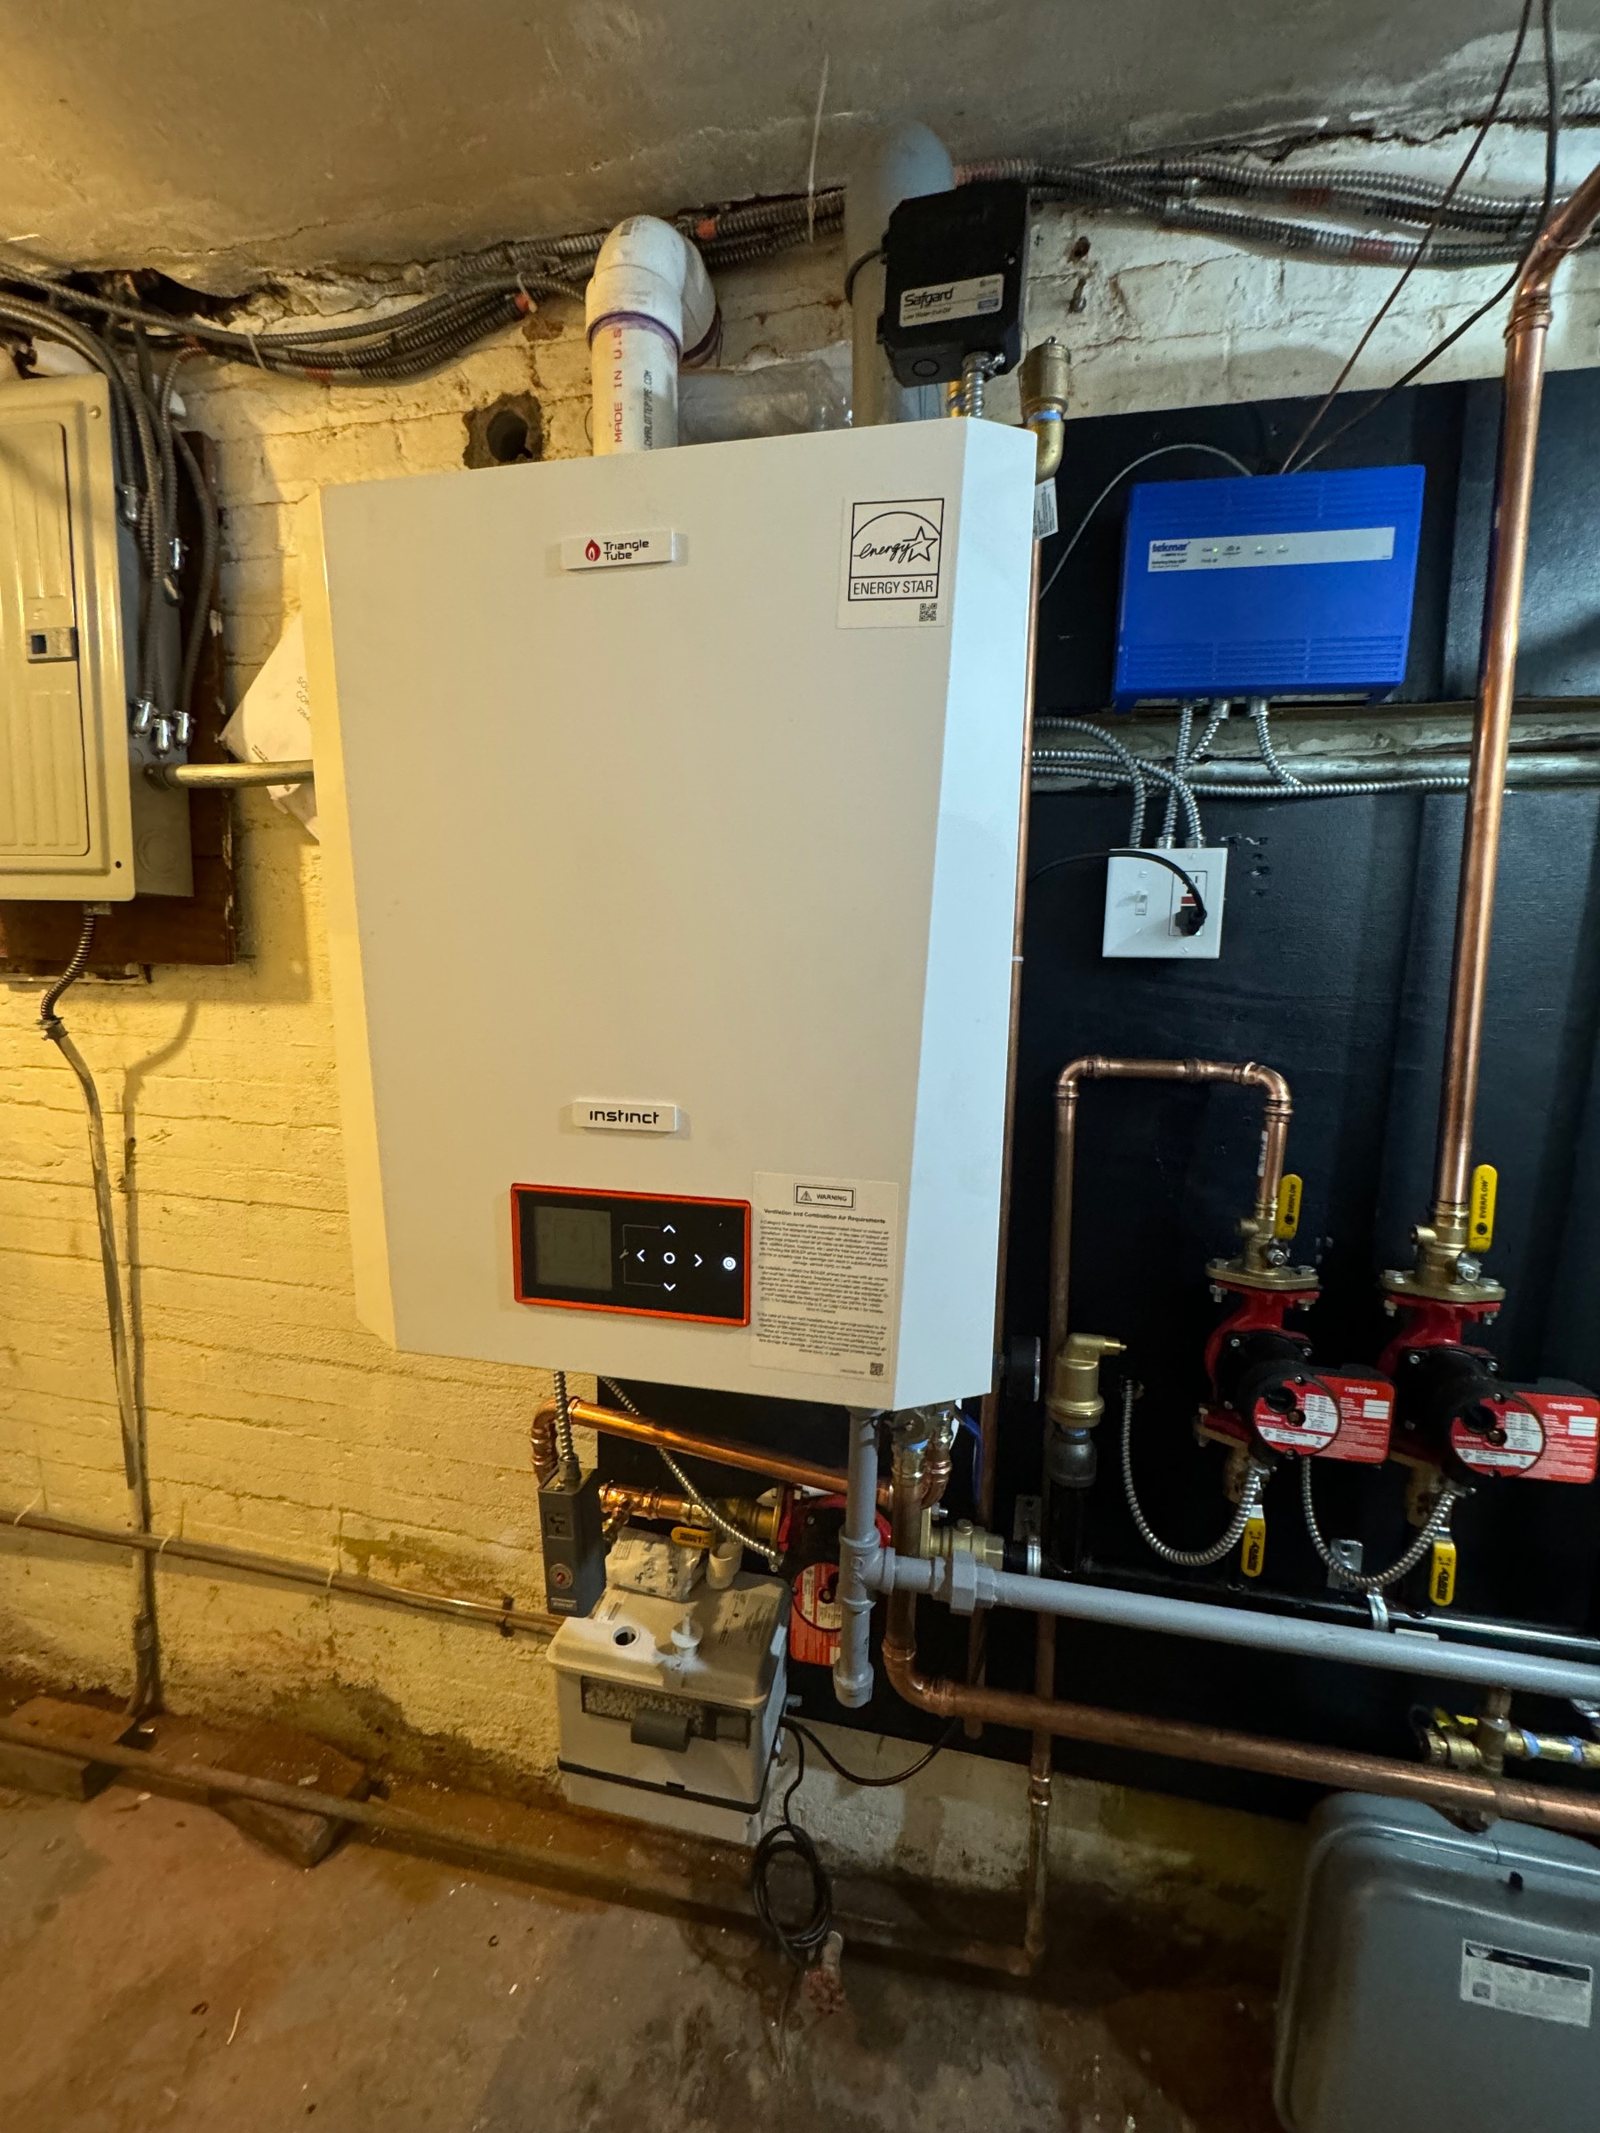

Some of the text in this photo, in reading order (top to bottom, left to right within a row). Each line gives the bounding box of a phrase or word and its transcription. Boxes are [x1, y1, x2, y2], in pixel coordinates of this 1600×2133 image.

[904, 287, 955, 309] Safgard
[614, 370, 622, 388] IN
[614, 401, 622, 443] MADE
[603, 539, 649, 552] Triangle
[853, 543, 922, 564] energy
[603, 551, 632, 561] Tube
[853, 580, 934, 595] ENERGY STAR
[589, 1109, 660, 1125] instinct
[816, 1194, 847, 1202] WARNING
[763, 1208, 792, 1216] Ventilation
[804, 1212, 837, 1220] Combustion
[848, 1215, 886, 1224] Requirements
